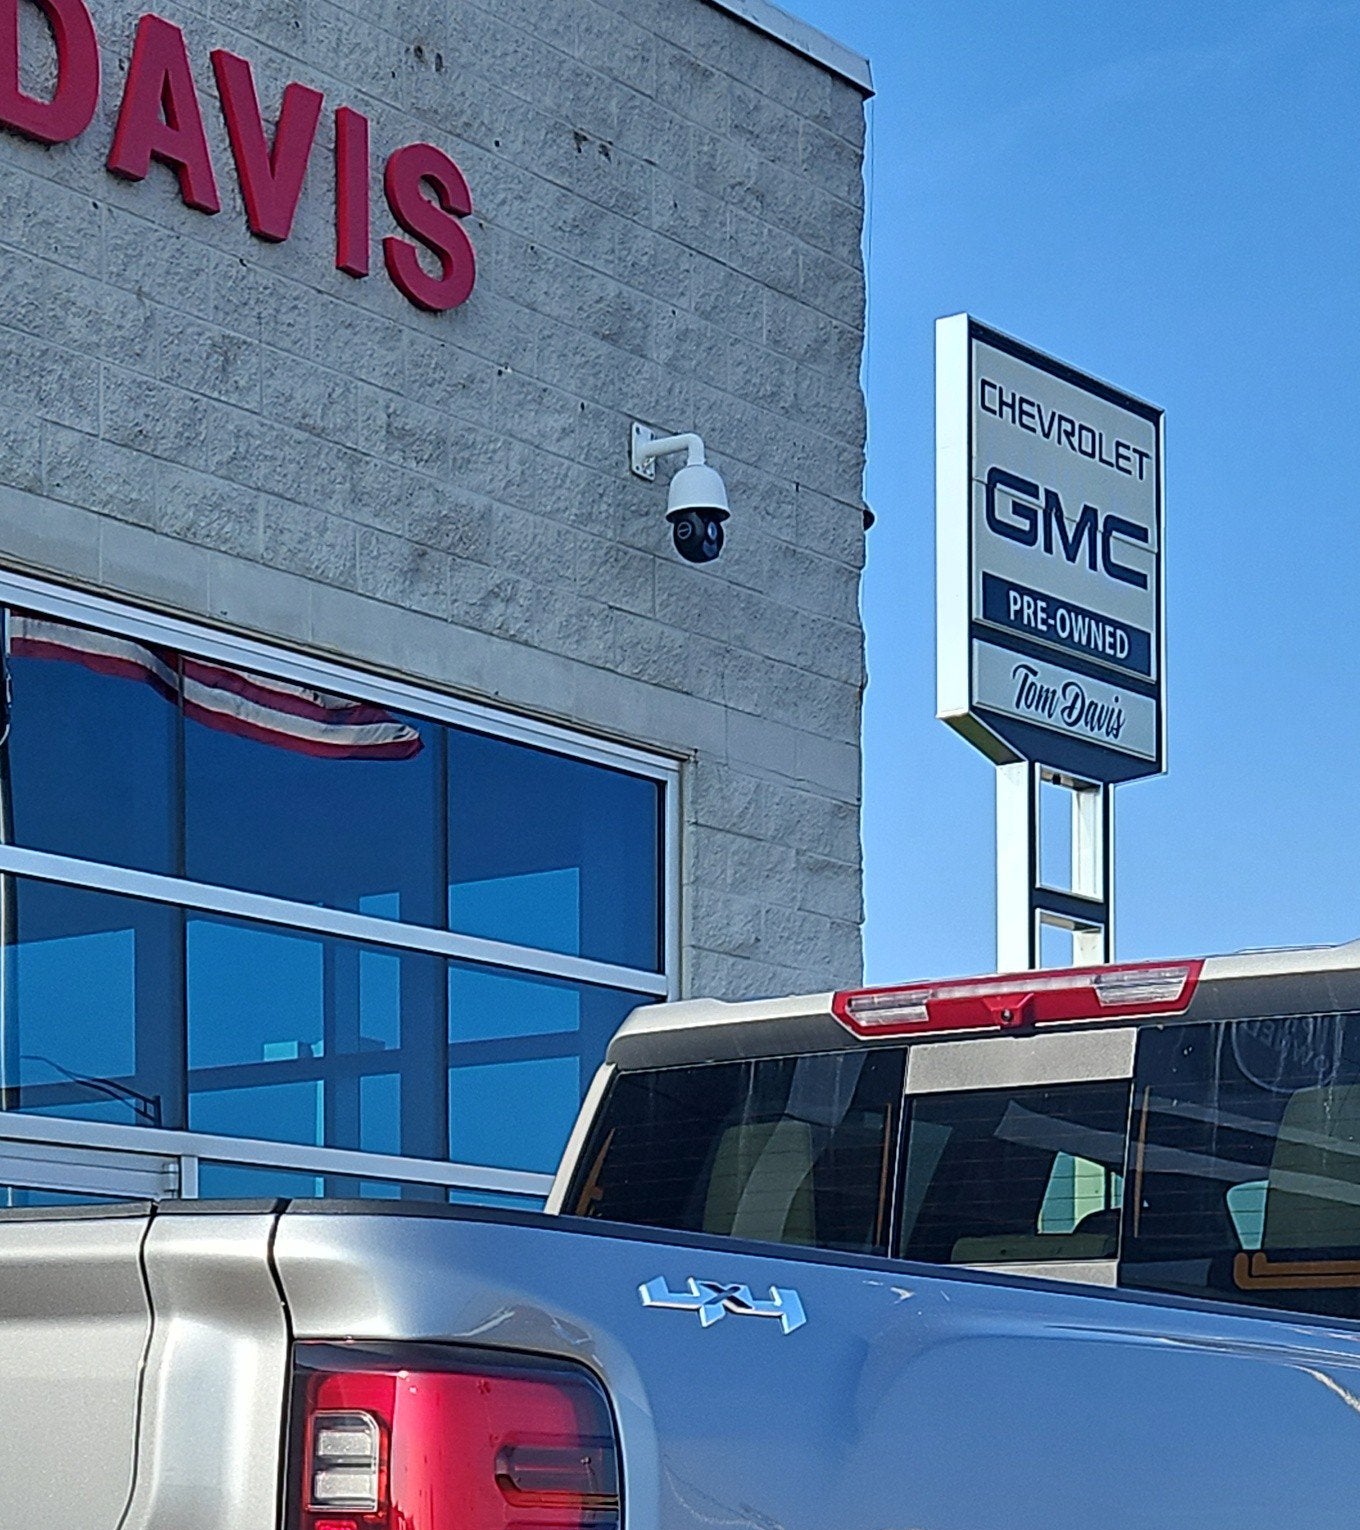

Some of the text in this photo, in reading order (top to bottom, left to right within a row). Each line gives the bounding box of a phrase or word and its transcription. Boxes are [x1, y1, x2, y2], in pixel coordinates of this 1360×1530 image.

[980, 378, 1151, 480] CHEVROLET
[986, 466, 1148, 590] GMC
[1008, 590, 1128, 659] PRE-OWNED
[1012, 664, 1126, 739] Tom Davis
